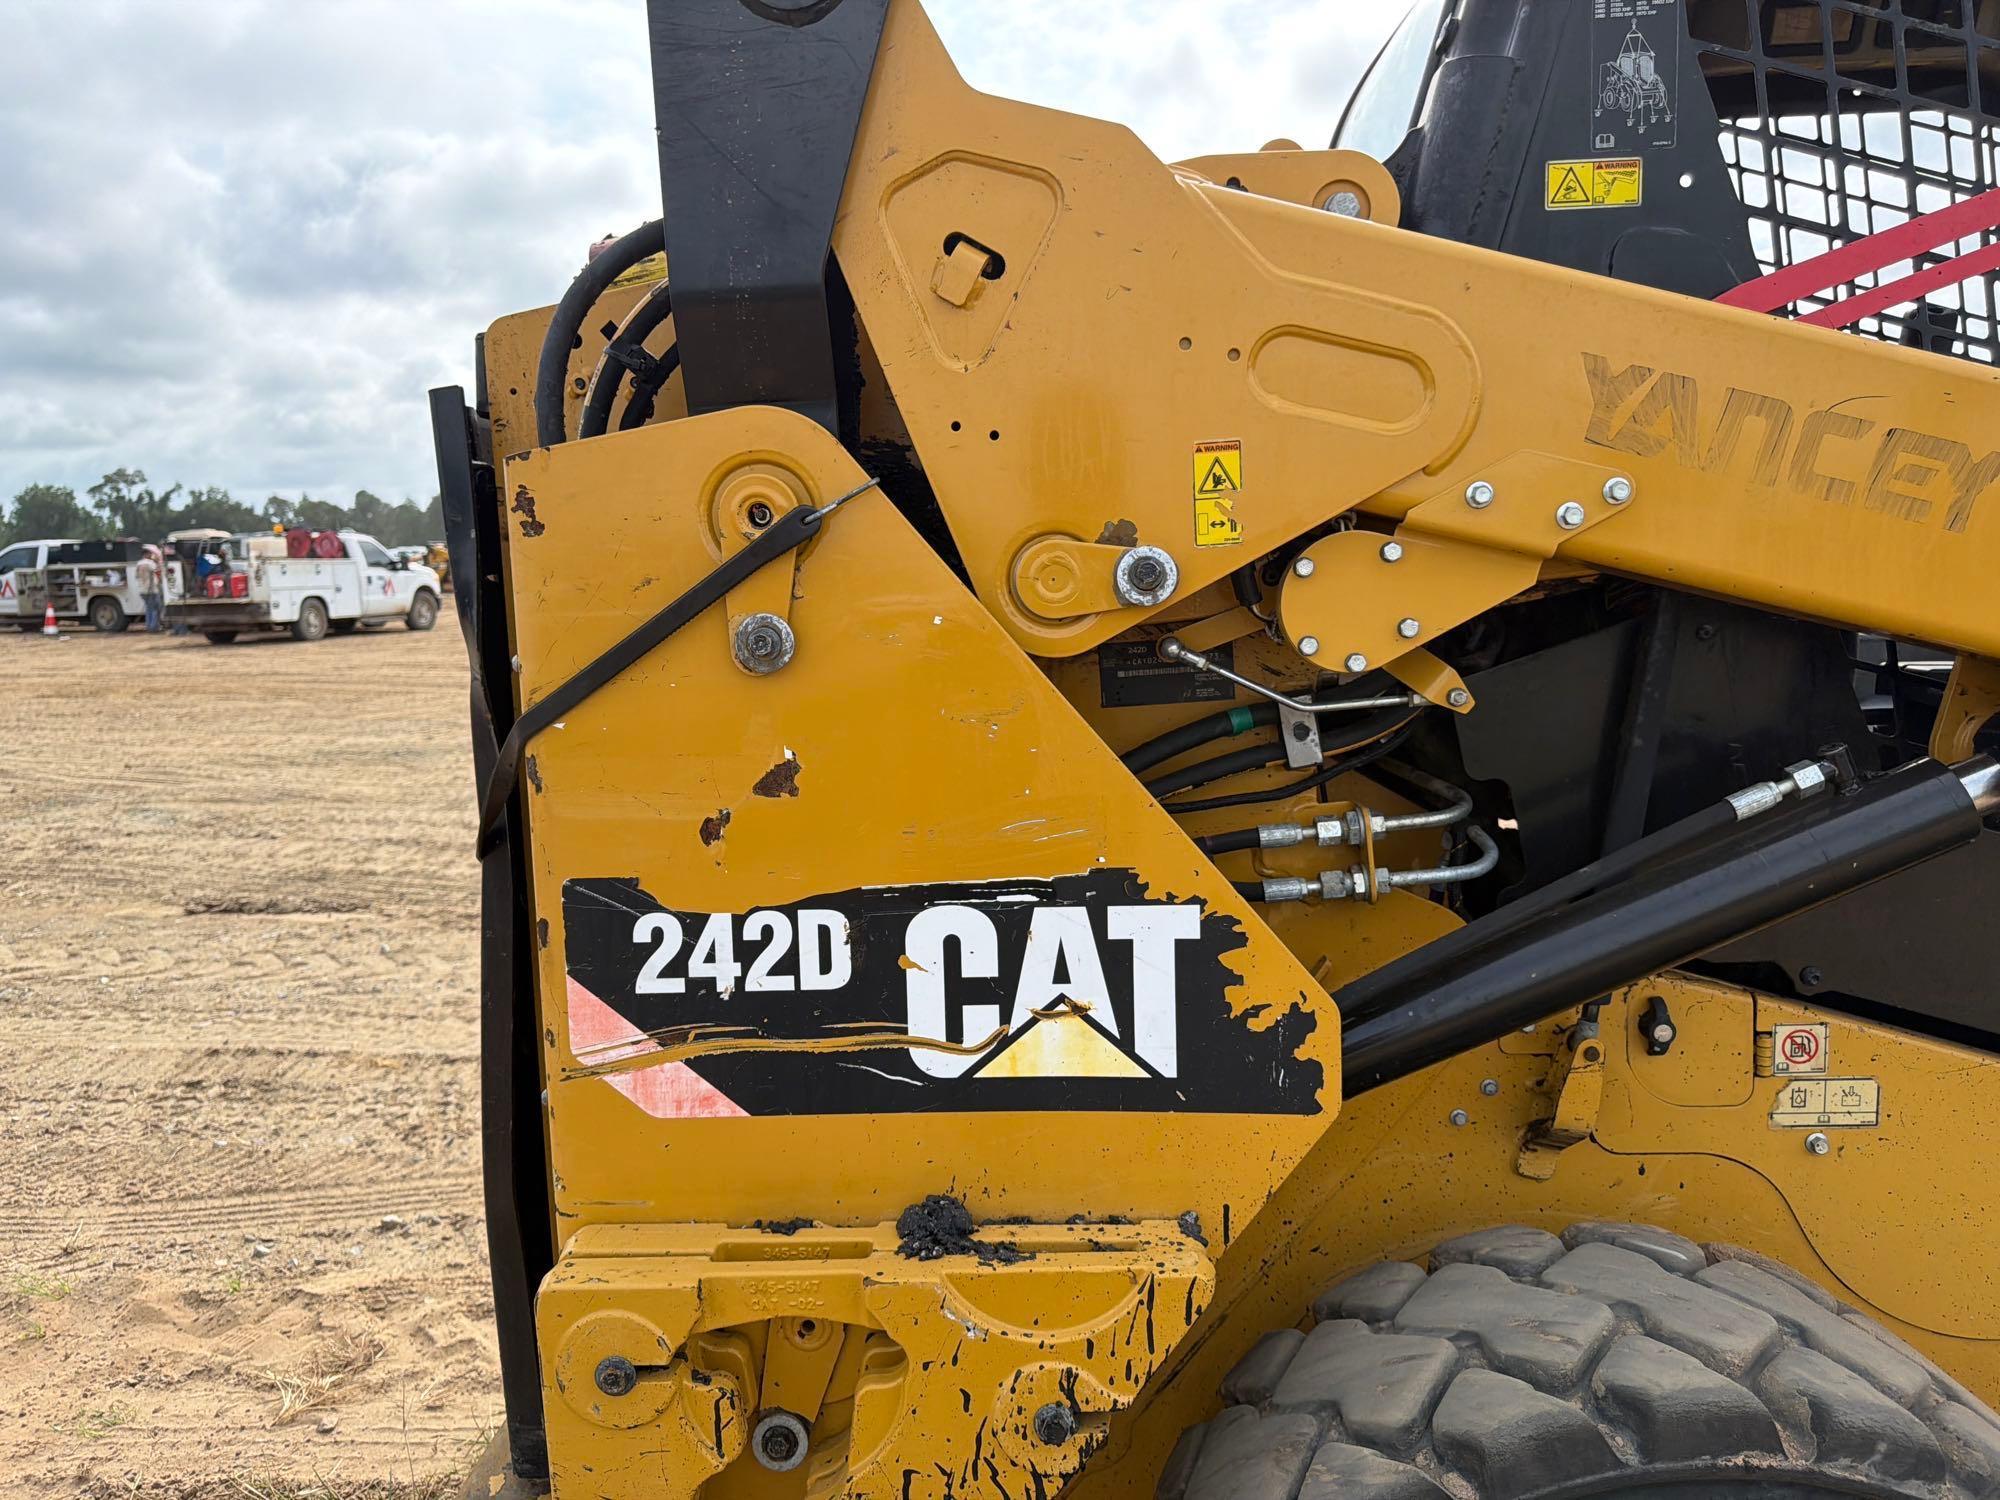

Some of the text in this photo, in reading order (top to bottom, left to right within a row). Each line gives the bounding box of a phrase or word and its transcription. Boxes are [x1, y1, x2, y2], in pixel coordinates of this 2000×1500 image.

[1604, 161, 1638, 170] WARNING
[1204, 443, 1239, 453] WARNING
[632, 904, 1201, 1079] 242D CAT
[763, 1247, 831, 1259] 345-5147
[749, 1280, 821, 1295] 345-5147
